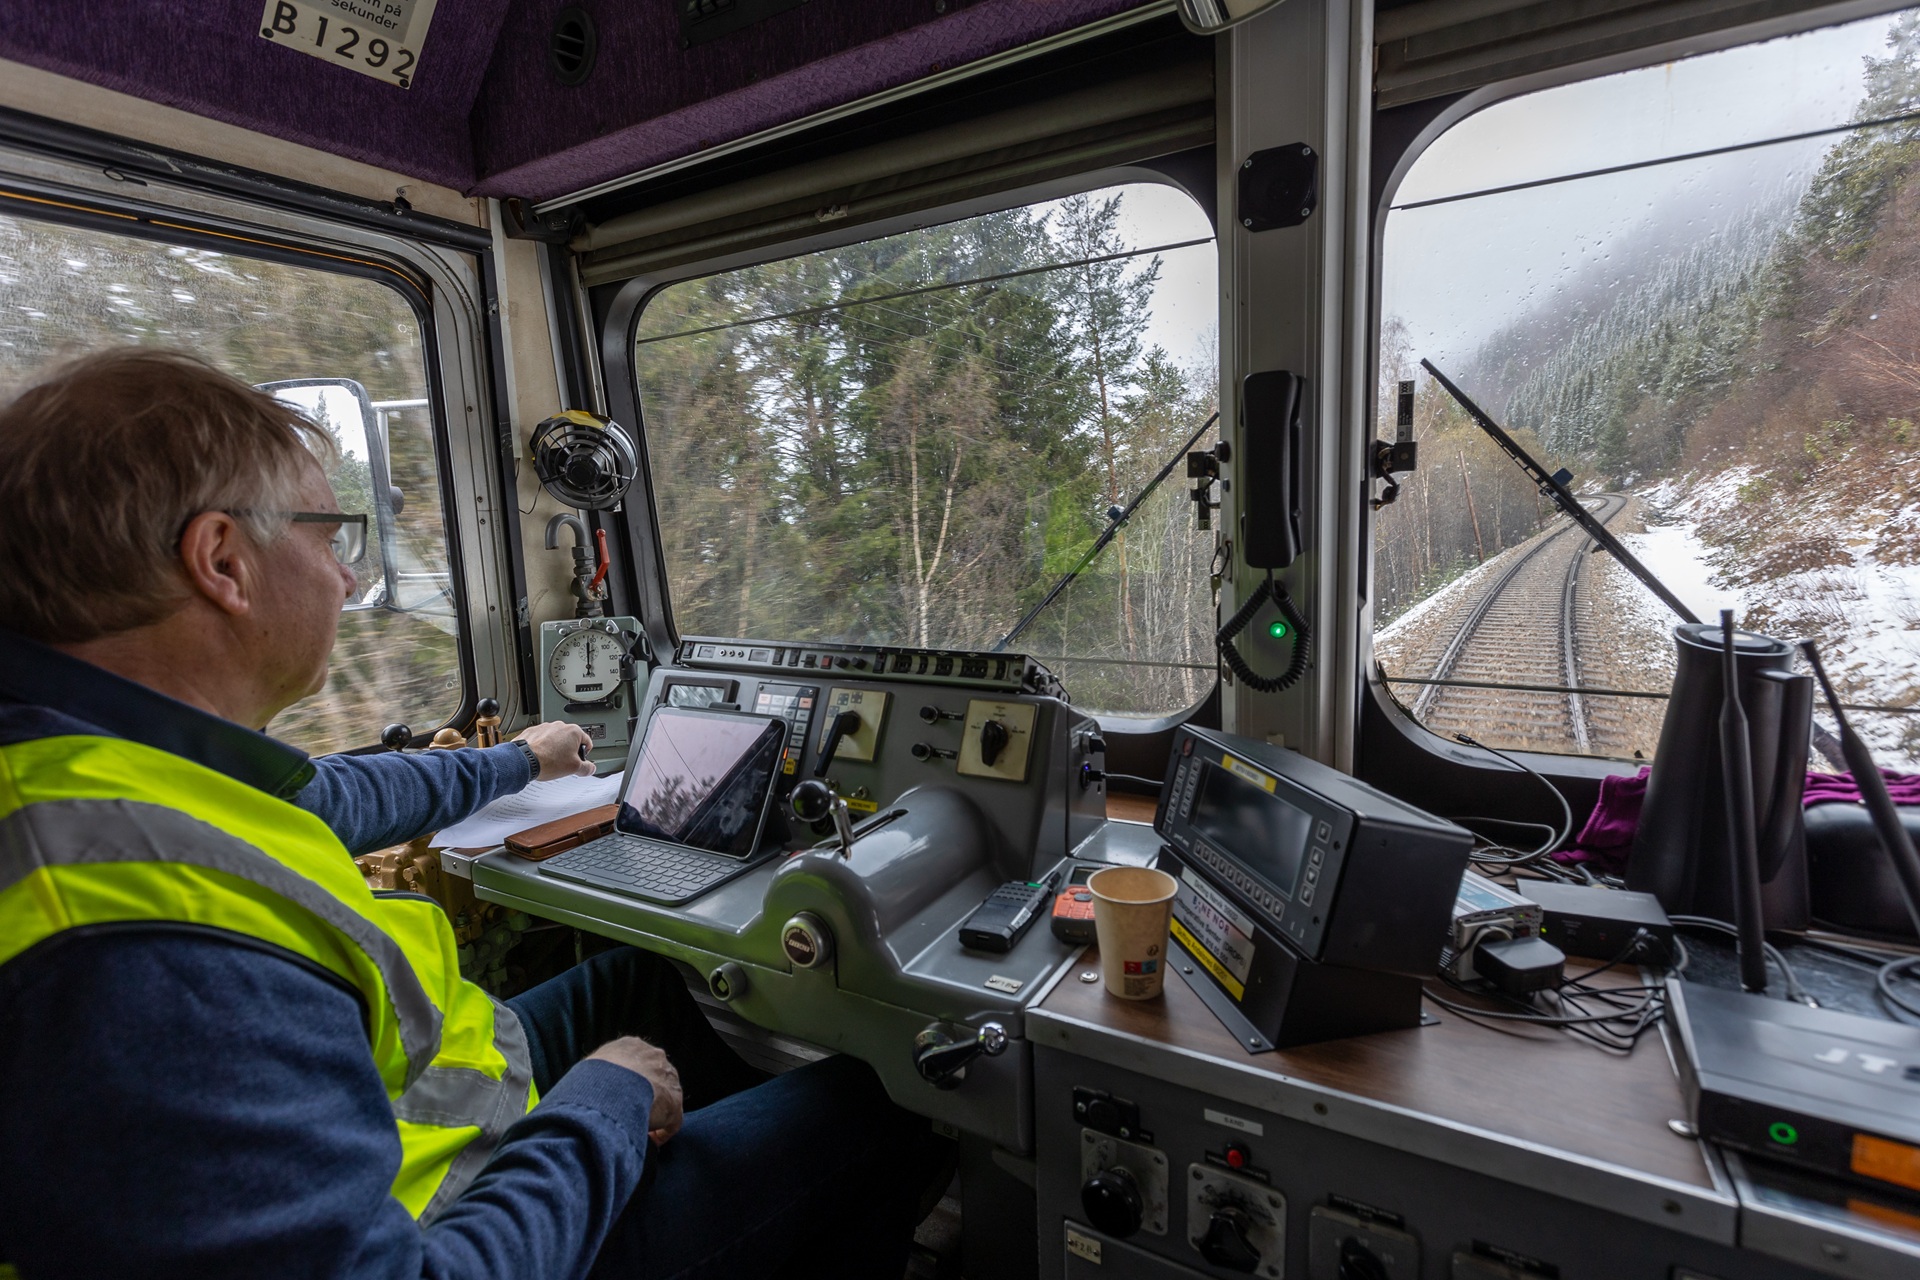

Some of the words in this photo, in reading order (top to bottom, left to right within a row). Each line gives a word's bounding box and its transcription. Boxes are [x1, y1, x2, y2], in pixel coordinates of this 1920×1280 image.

[331, 0, 398, 29] sekunder
[384, 4, 401, 17] på
[272, 0, 297, 34] B
[315, 16, 415, 79] 1292
[1212, 913, 1230, 935] NOR
